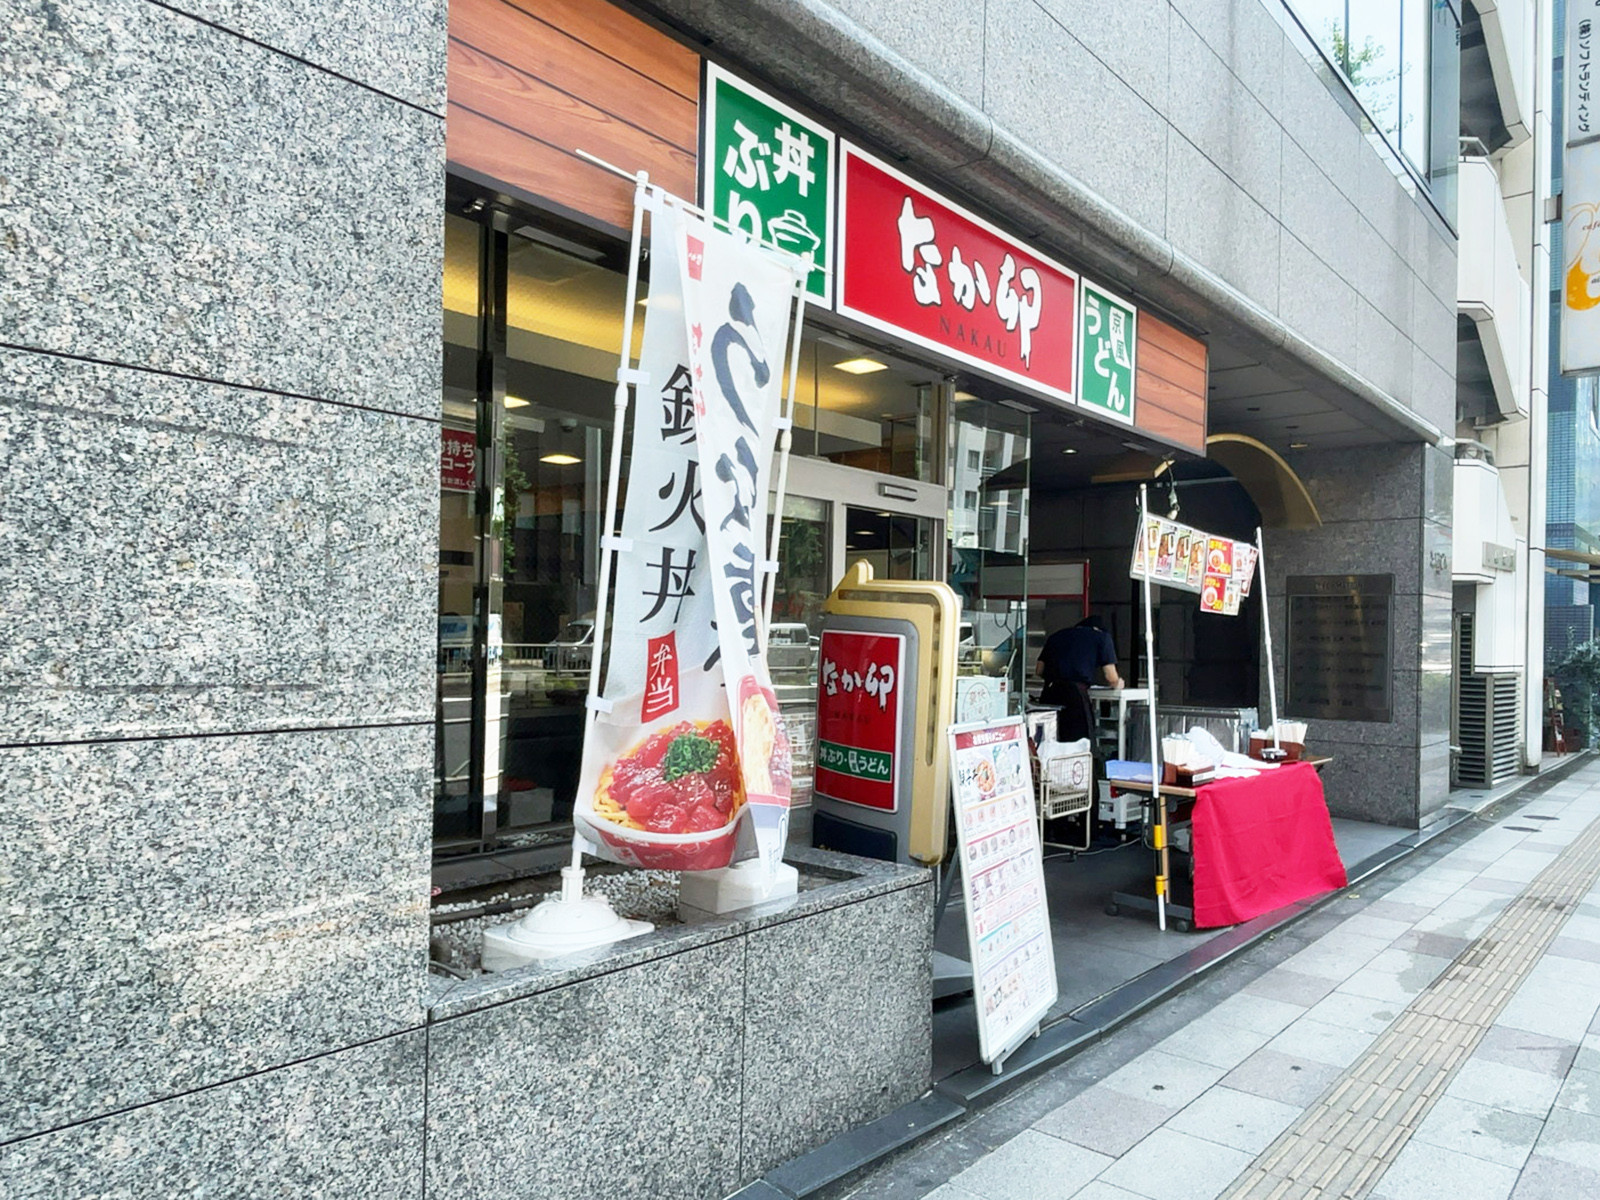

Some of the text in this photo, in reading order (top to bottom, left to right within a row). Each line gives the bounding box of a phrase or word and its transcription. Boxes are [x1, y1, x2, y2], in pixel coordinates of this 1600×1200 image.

[897, 195, 1043, 371] なか卯
[938, 314, 1008, 358] NAKAU
[1085, 294, 1126, 412] うどん
[645, 642, 674, 714] 弁当
[822, 656, 895, 713] なか卯
